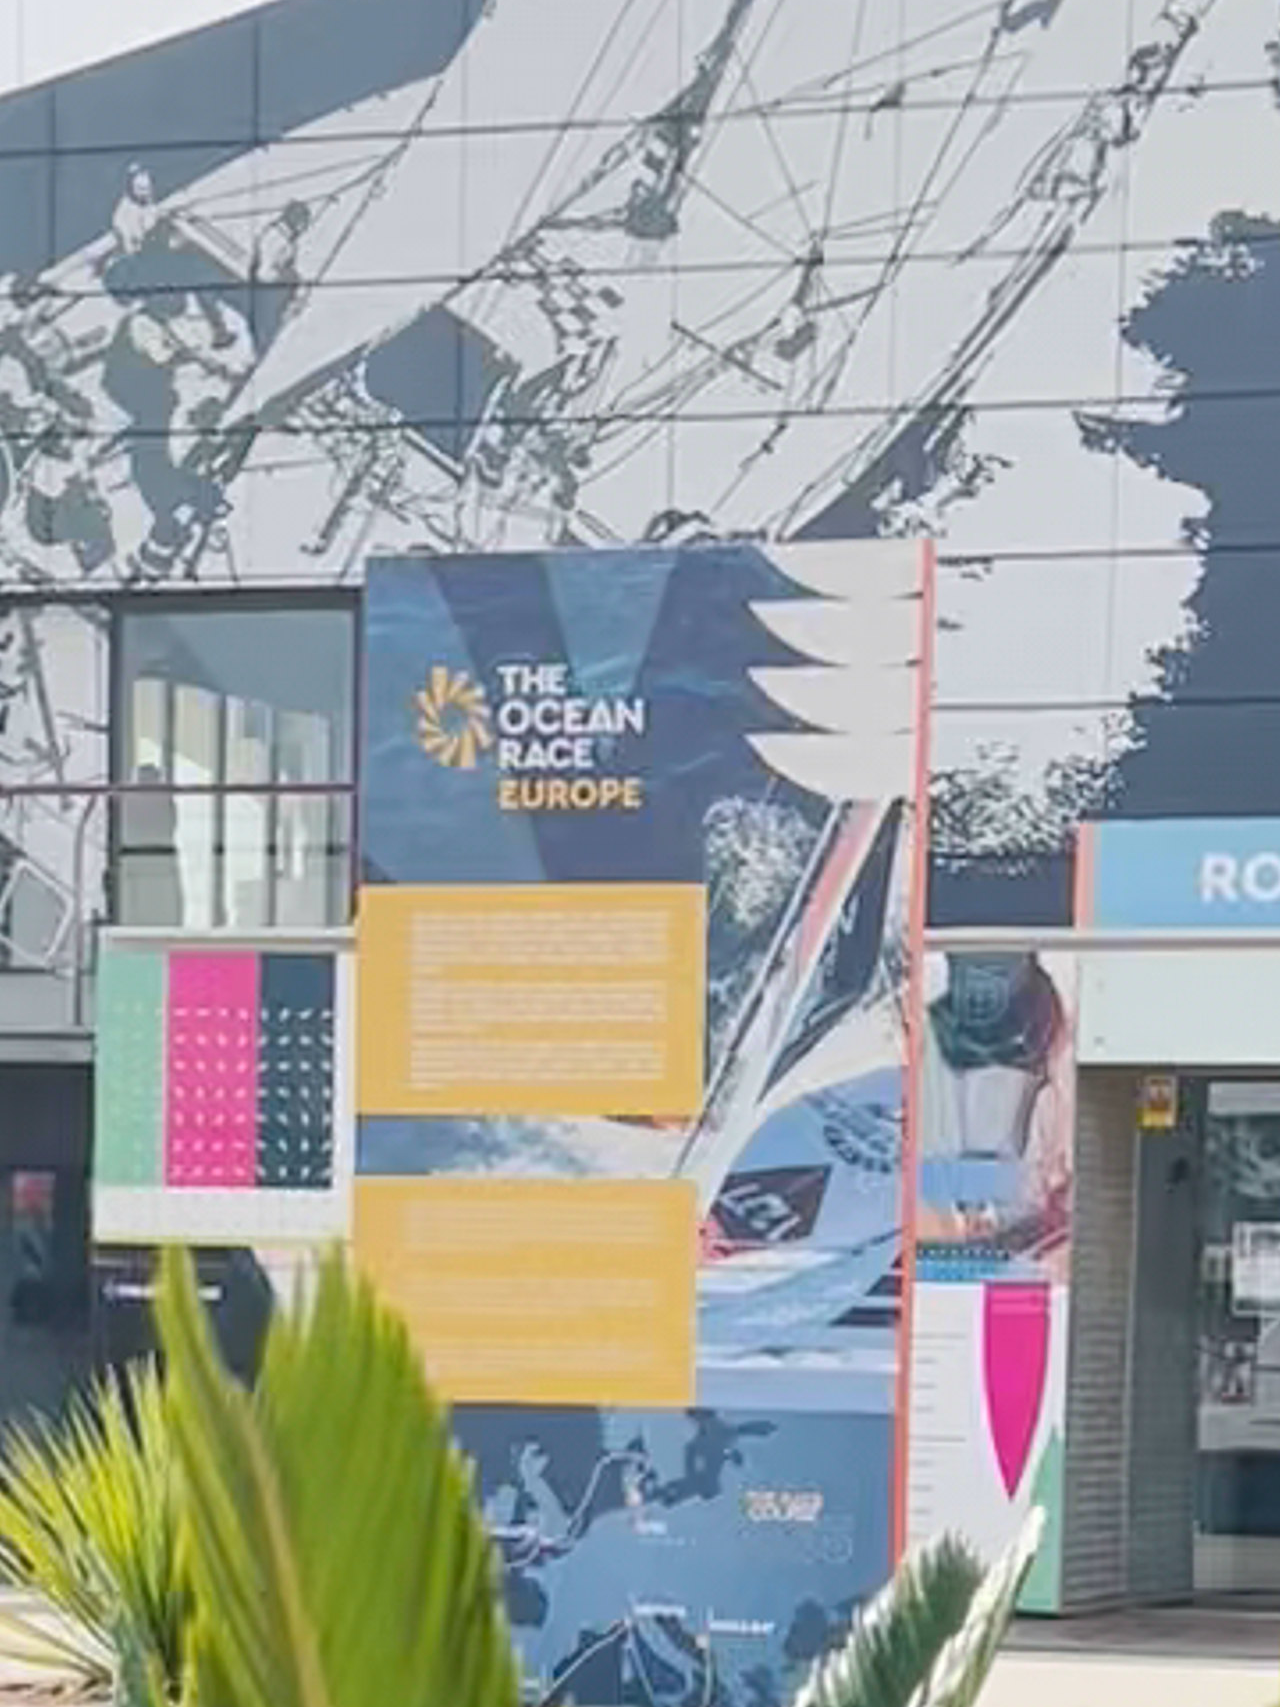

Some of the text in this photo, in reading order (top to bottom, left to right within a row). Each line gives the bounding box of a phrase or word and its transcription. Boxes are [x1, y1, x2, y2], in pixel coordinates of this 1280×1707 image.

[497, 664, 568, 697] THE
[497, 699, 645, 735] OCEAN
[498, 737, 595, 770] RACE
[497, 777, 643, 811] EUROPE
